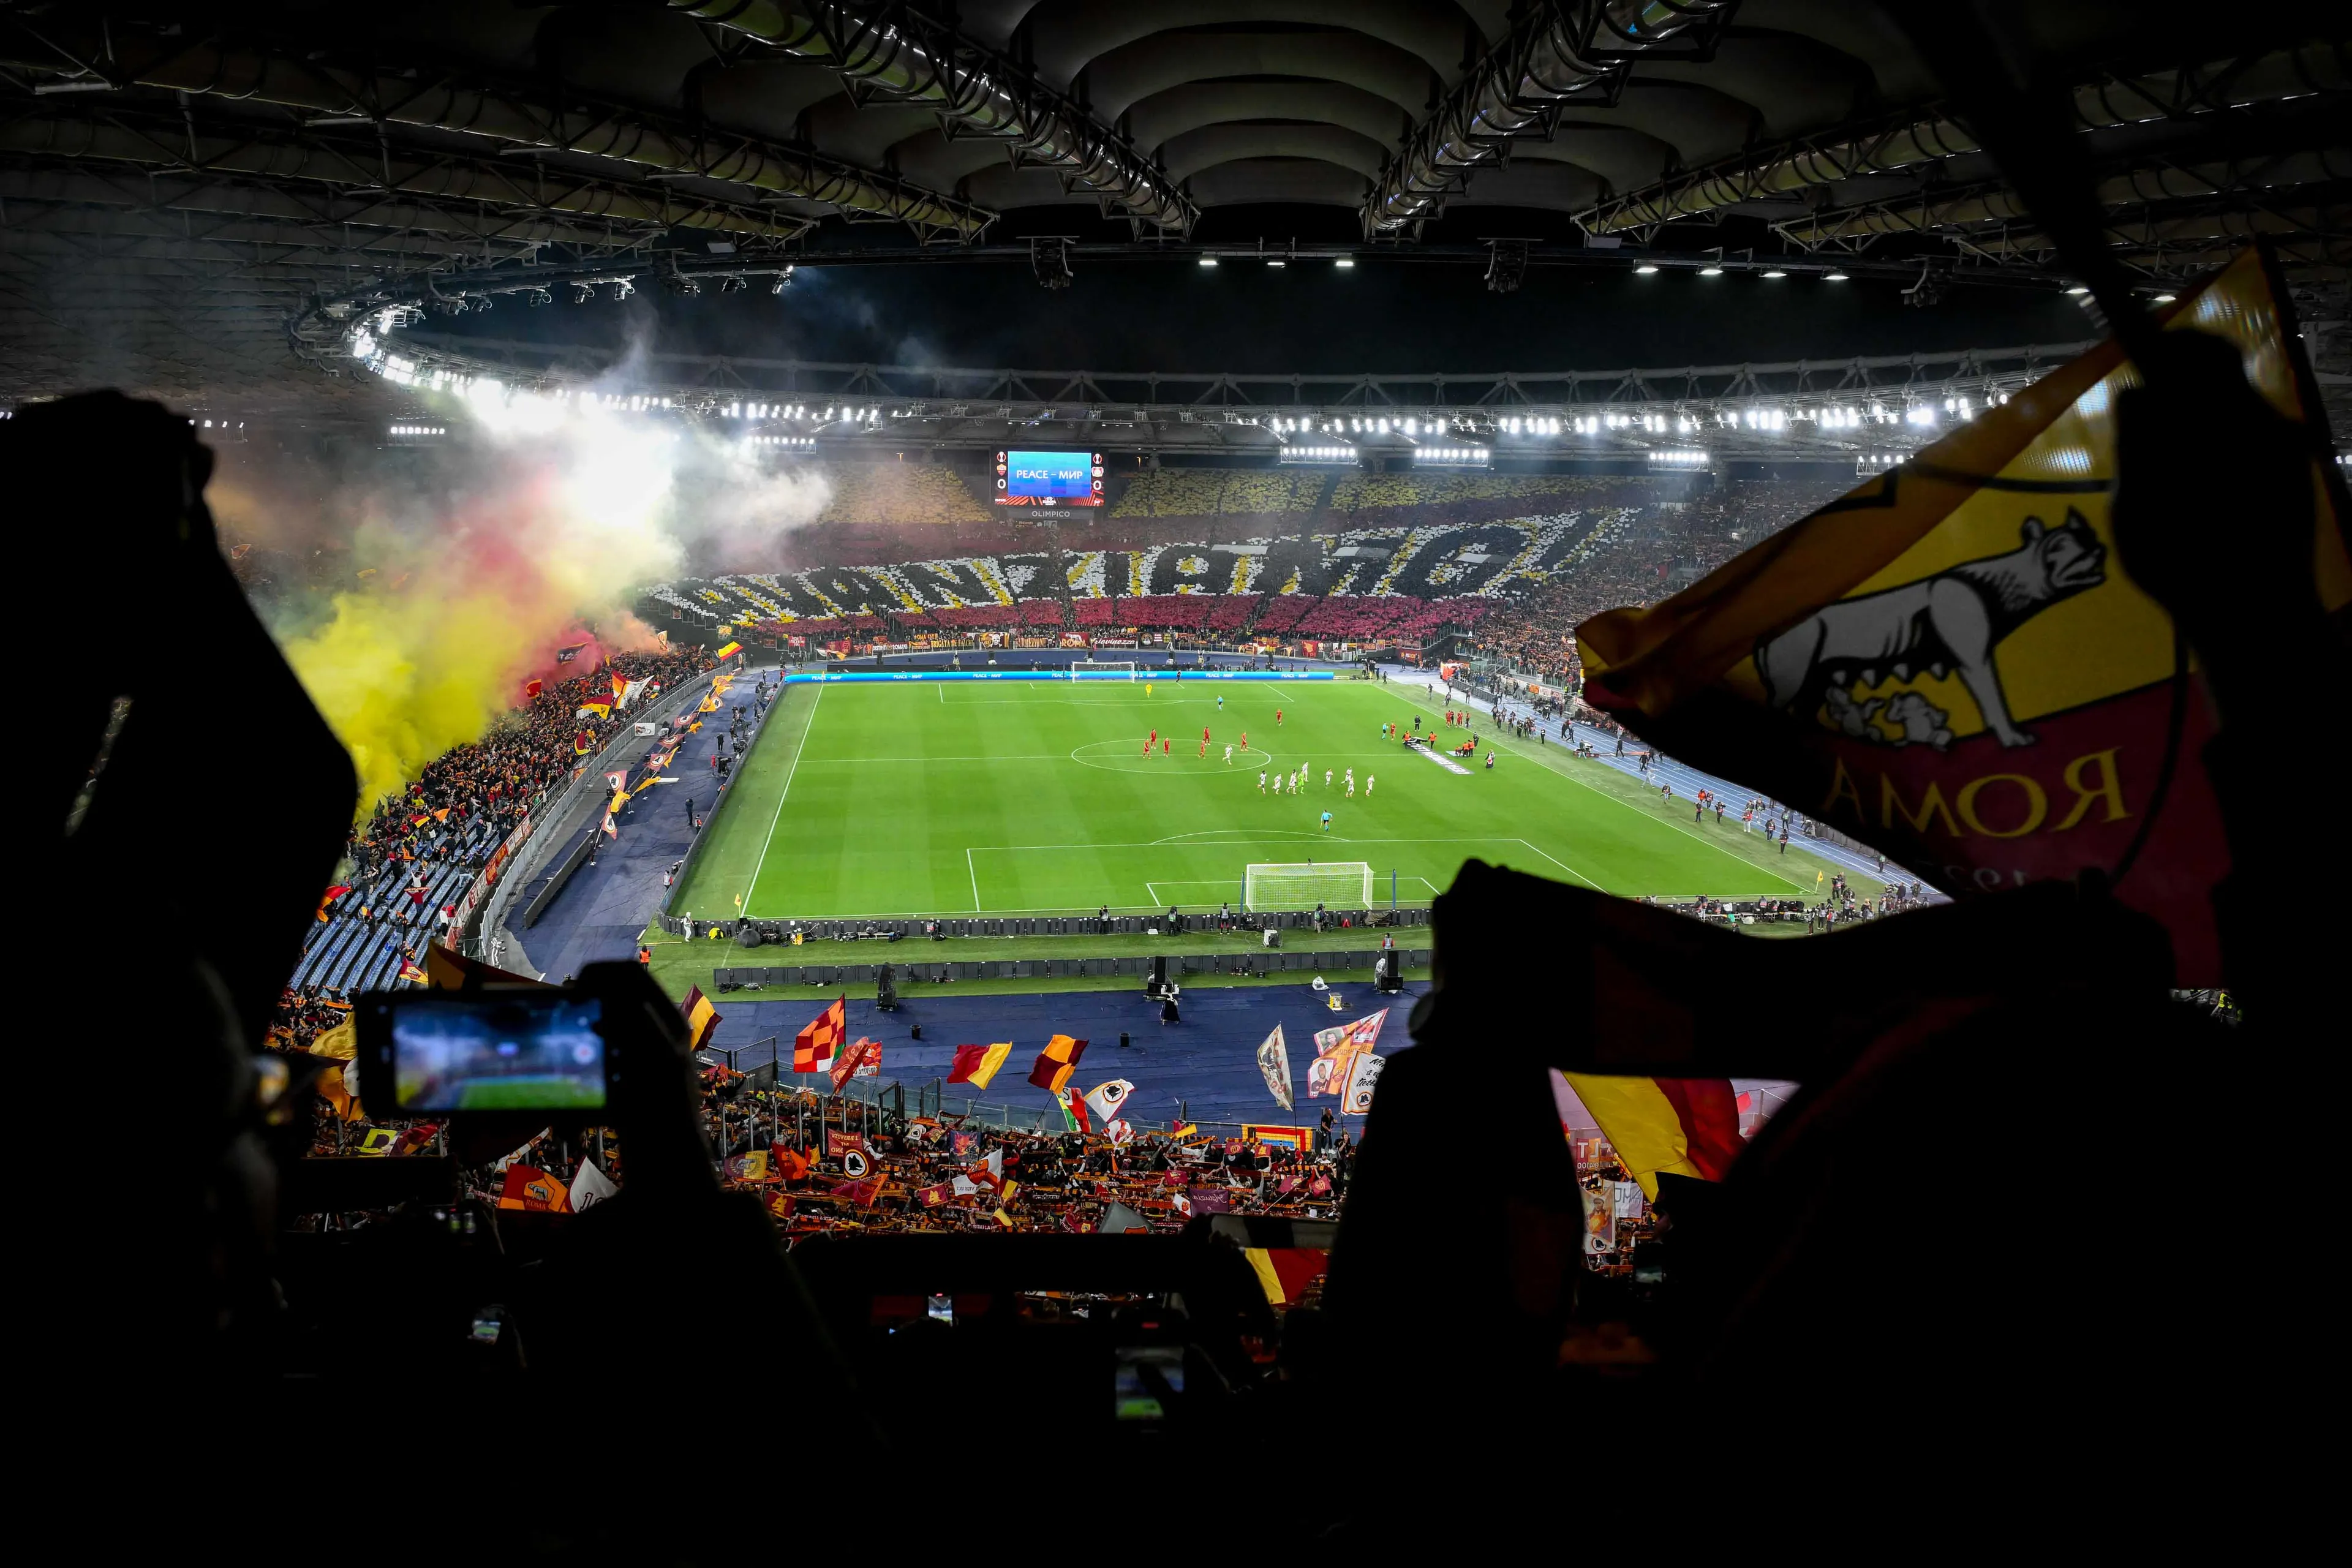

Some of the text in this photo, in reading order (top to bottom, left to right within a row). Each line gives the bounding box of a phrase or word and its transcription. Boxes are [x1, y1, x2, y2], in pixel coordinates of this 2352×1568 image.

[1016, 470, 1049, 479] PEACE
[1058, 470, 1083, 480] МИР
[997, 478, 1006, 489] 0
[1093, 480, 1102, 491] 0
[1061, 638, 1087, 648] ROMA
[526, 1199, 546, 1210] ROMA
[579, 1191, 604, 1212] 1
